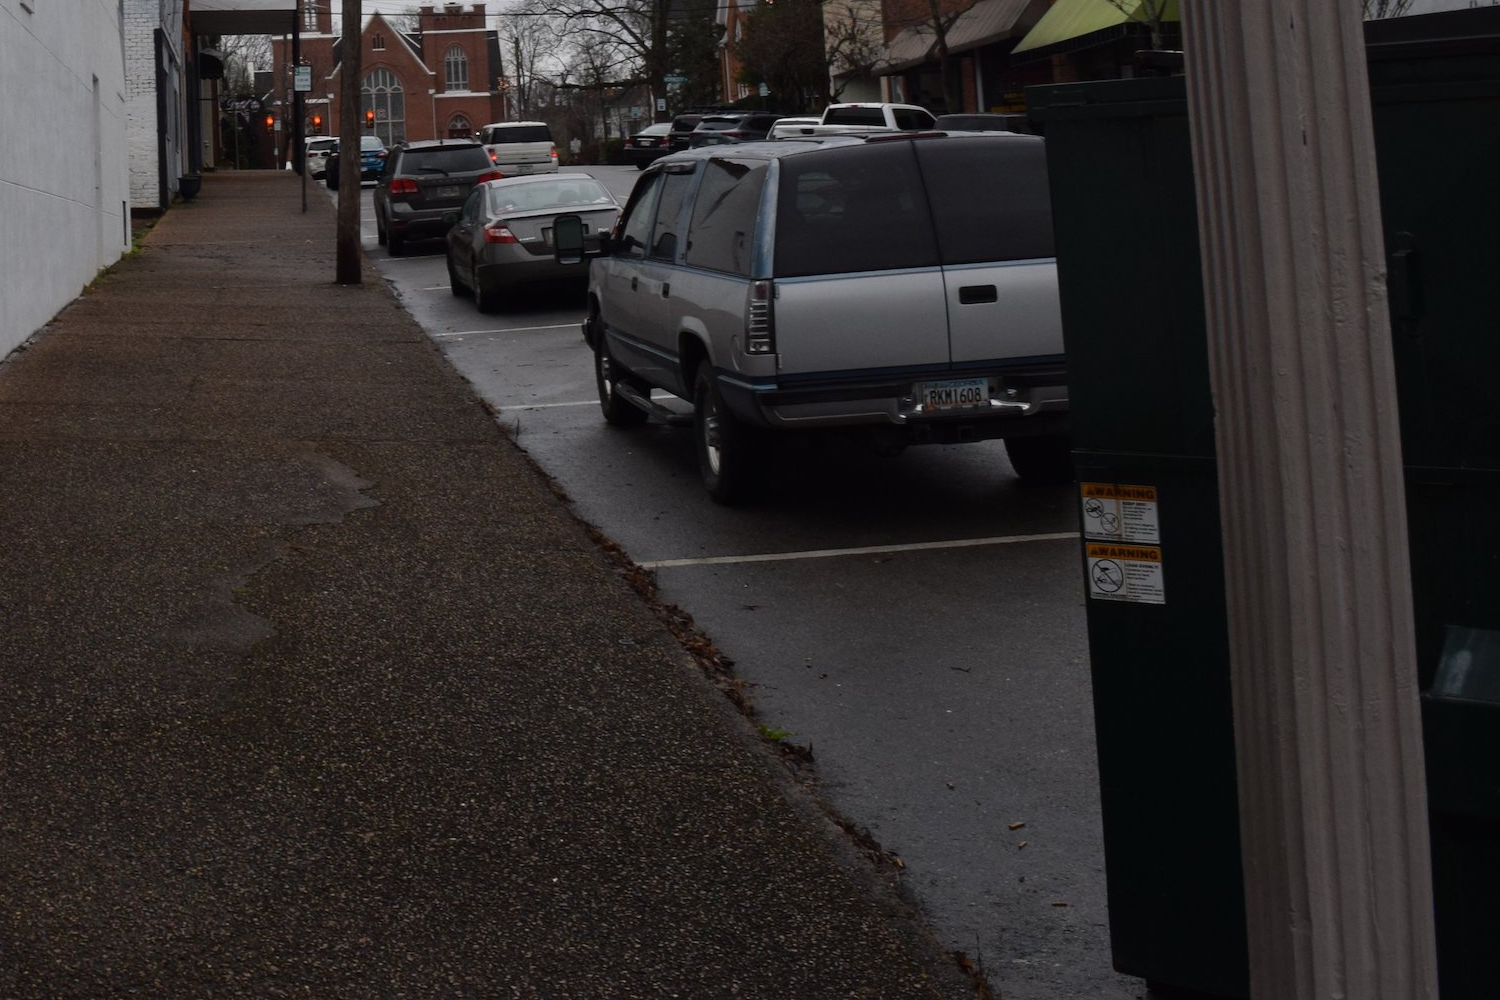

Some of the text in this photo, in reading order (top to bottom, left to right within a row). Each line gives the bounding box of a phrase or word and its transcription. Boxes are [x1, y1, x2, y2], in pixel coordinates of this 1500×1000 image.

[930, 387, 981, 405] RKM1608
[1093, 487, 1154, 500] WARNING
[1098, 547, 1158, 561] WARNING
